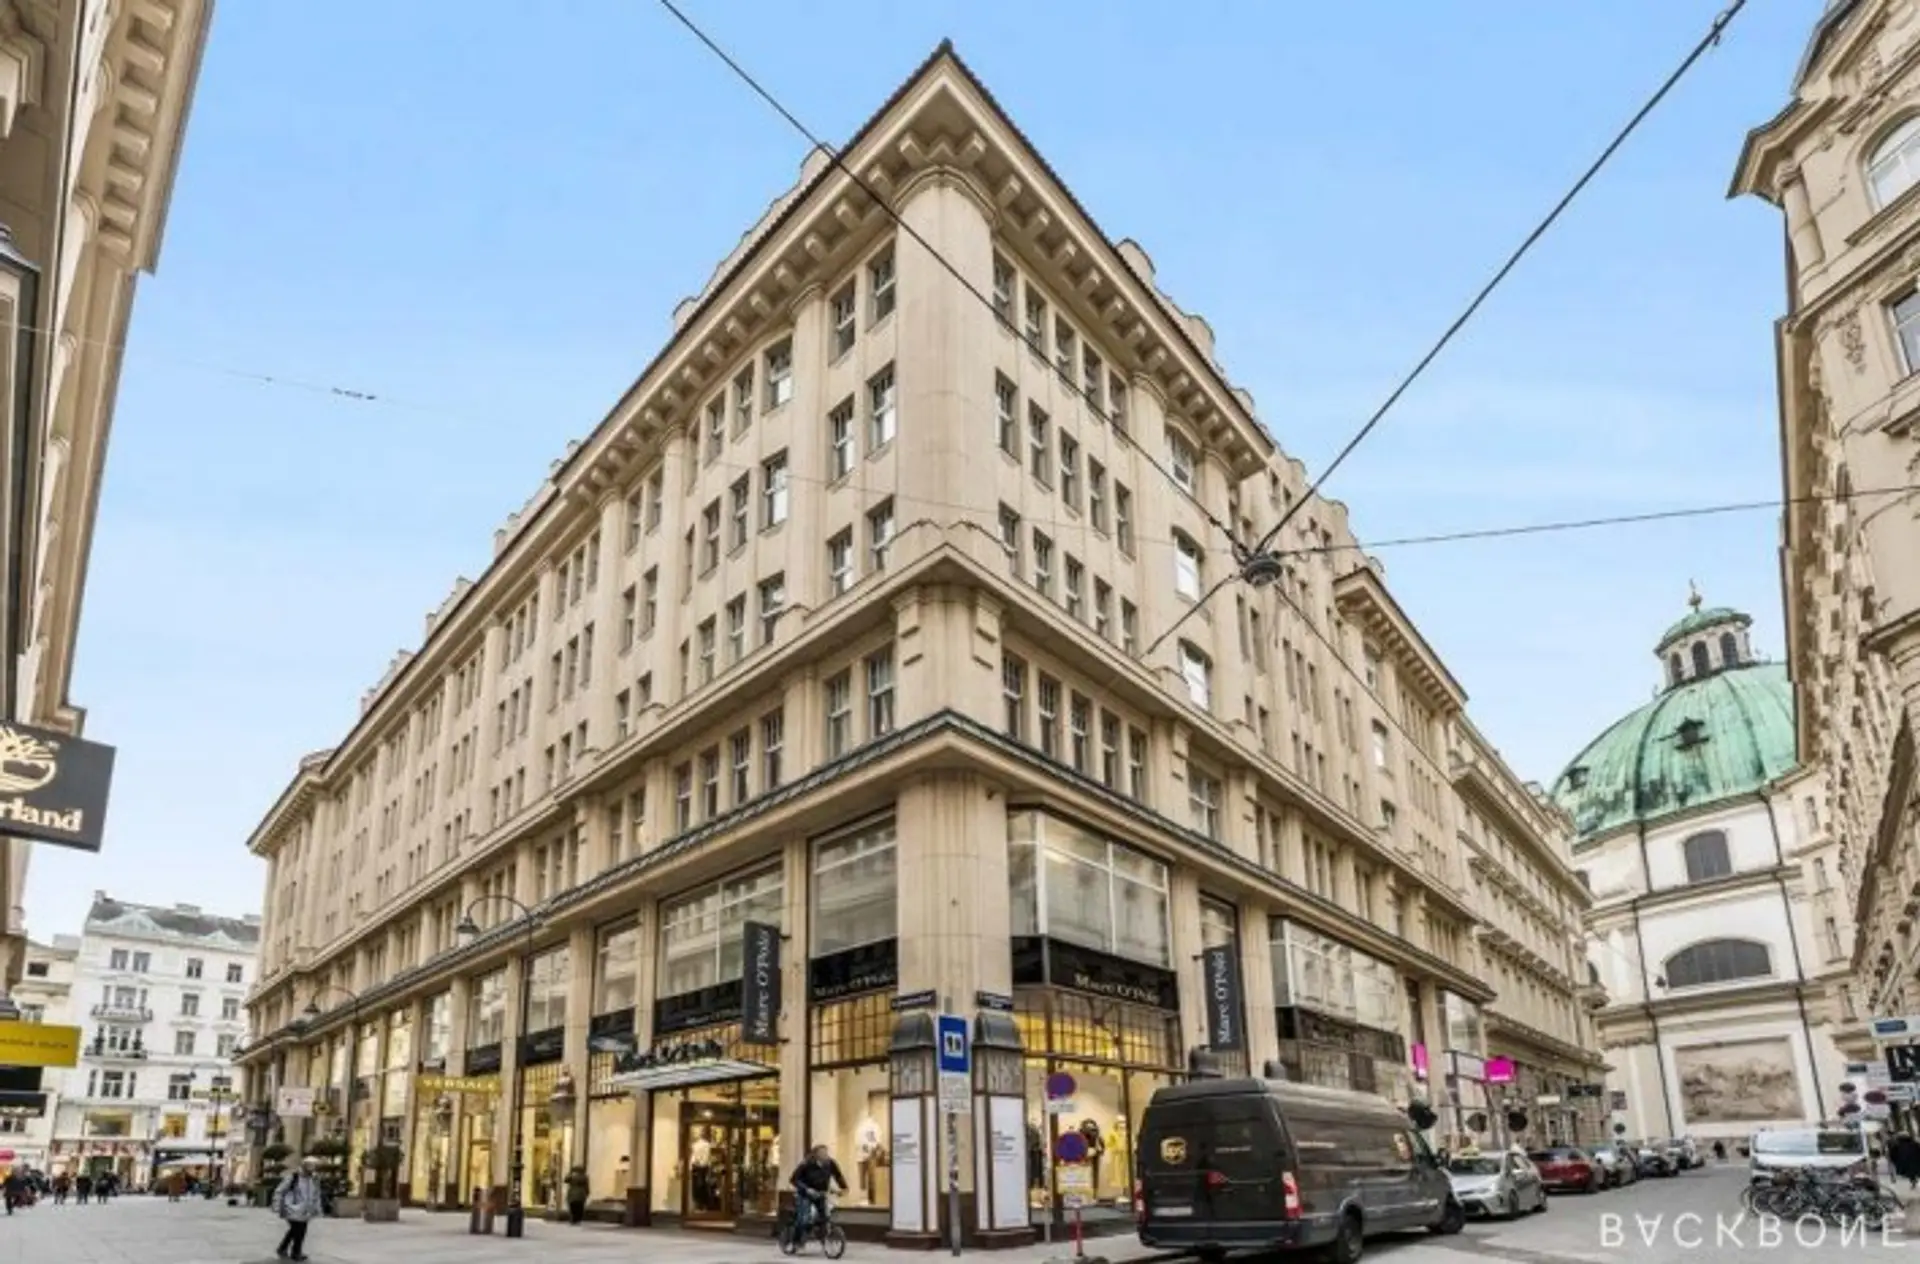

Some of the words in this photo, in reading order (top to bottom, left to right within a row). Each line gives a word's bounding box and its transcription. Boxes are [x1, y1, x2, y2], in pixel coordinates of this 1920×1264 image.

[1074, 972, 1115, 994] Marc
[754, 990, 769, 1037] Marc
[1217, 1003, 1232, 1043] Marc
